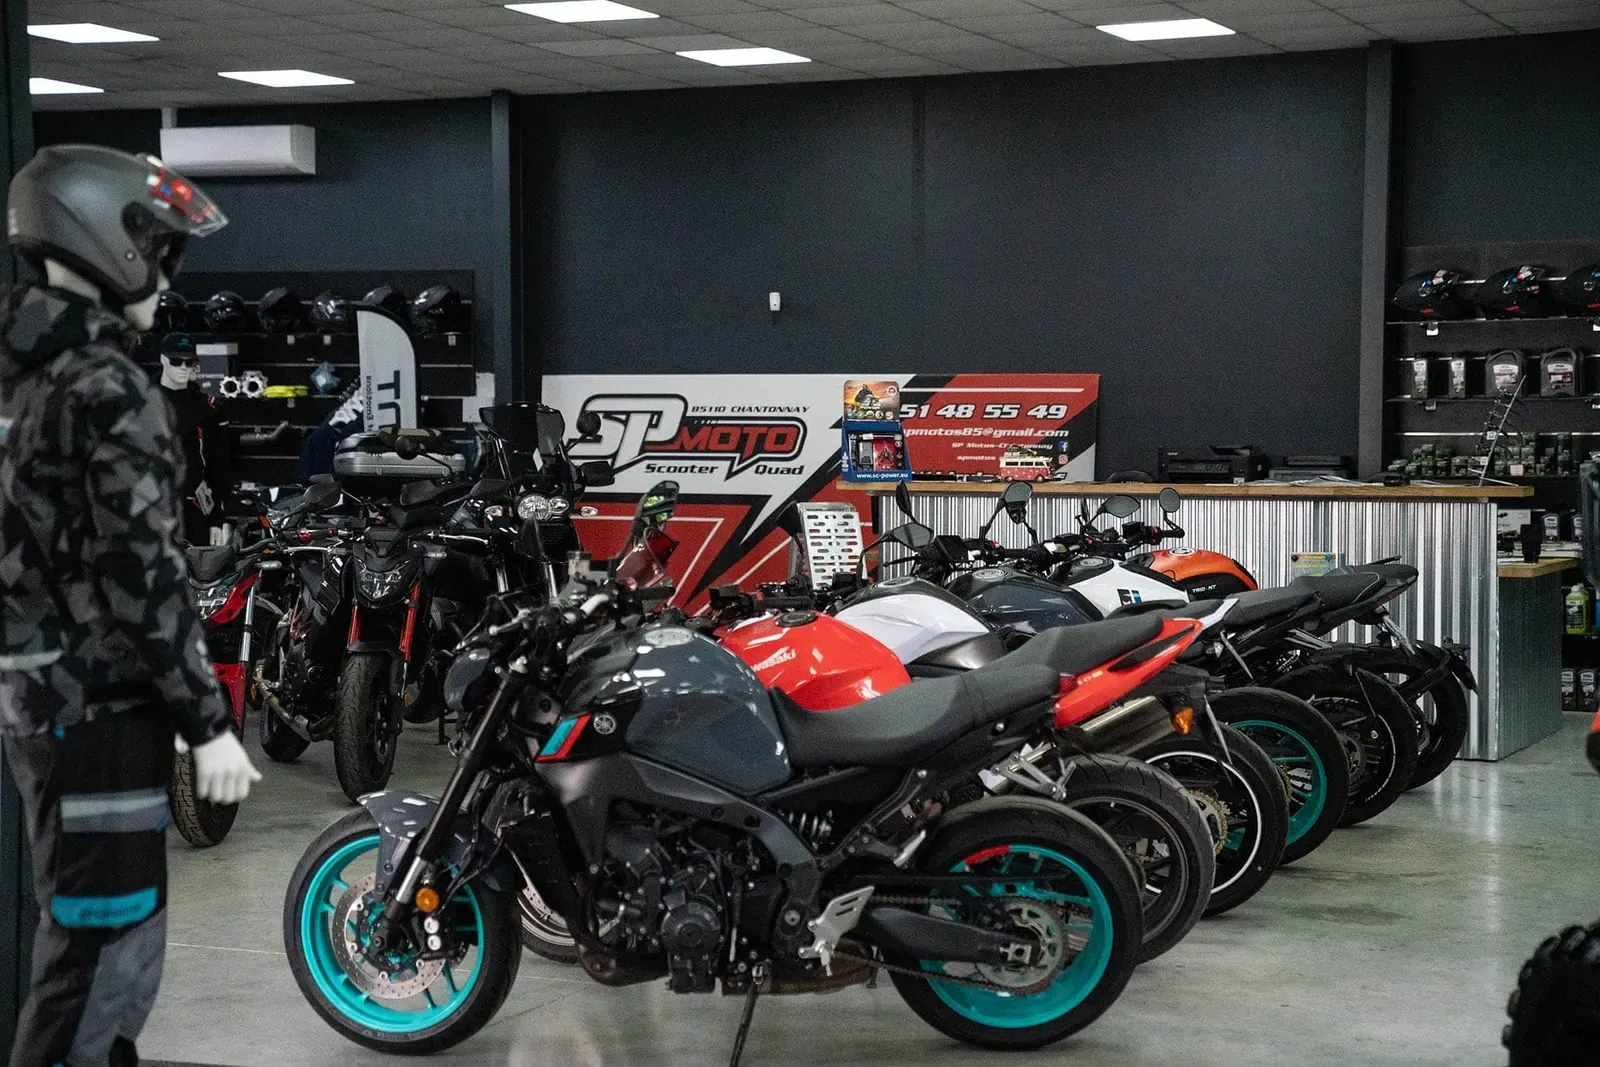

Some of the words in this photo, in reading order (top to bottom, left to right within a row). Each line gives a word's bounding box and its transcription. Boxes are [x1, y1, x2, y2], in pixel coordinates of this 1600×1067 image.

[691, 405, 726, 413] 85110
[730, 405, 810, 413] CHANTONNAY
[899, 403, 931, 419] 51
[936, 403, 976, 420] 48
[982, 403, 1020, 420] 55
[1026, 404, 1068, 420] 49
[566, 393, 688, 474] SP
[903, 427, 1069, 438] pmotos85@gmail.com
[672, 425, 801, 460] MOTO
[957, 454, 996, 462] spmotos
[645, 463, 719, 474] Scooter
[754, 464, 804, 475] Quad
[856, 472, 909, 480] www.sc-power.eu
[750, 649, 796, 672] wasaki
